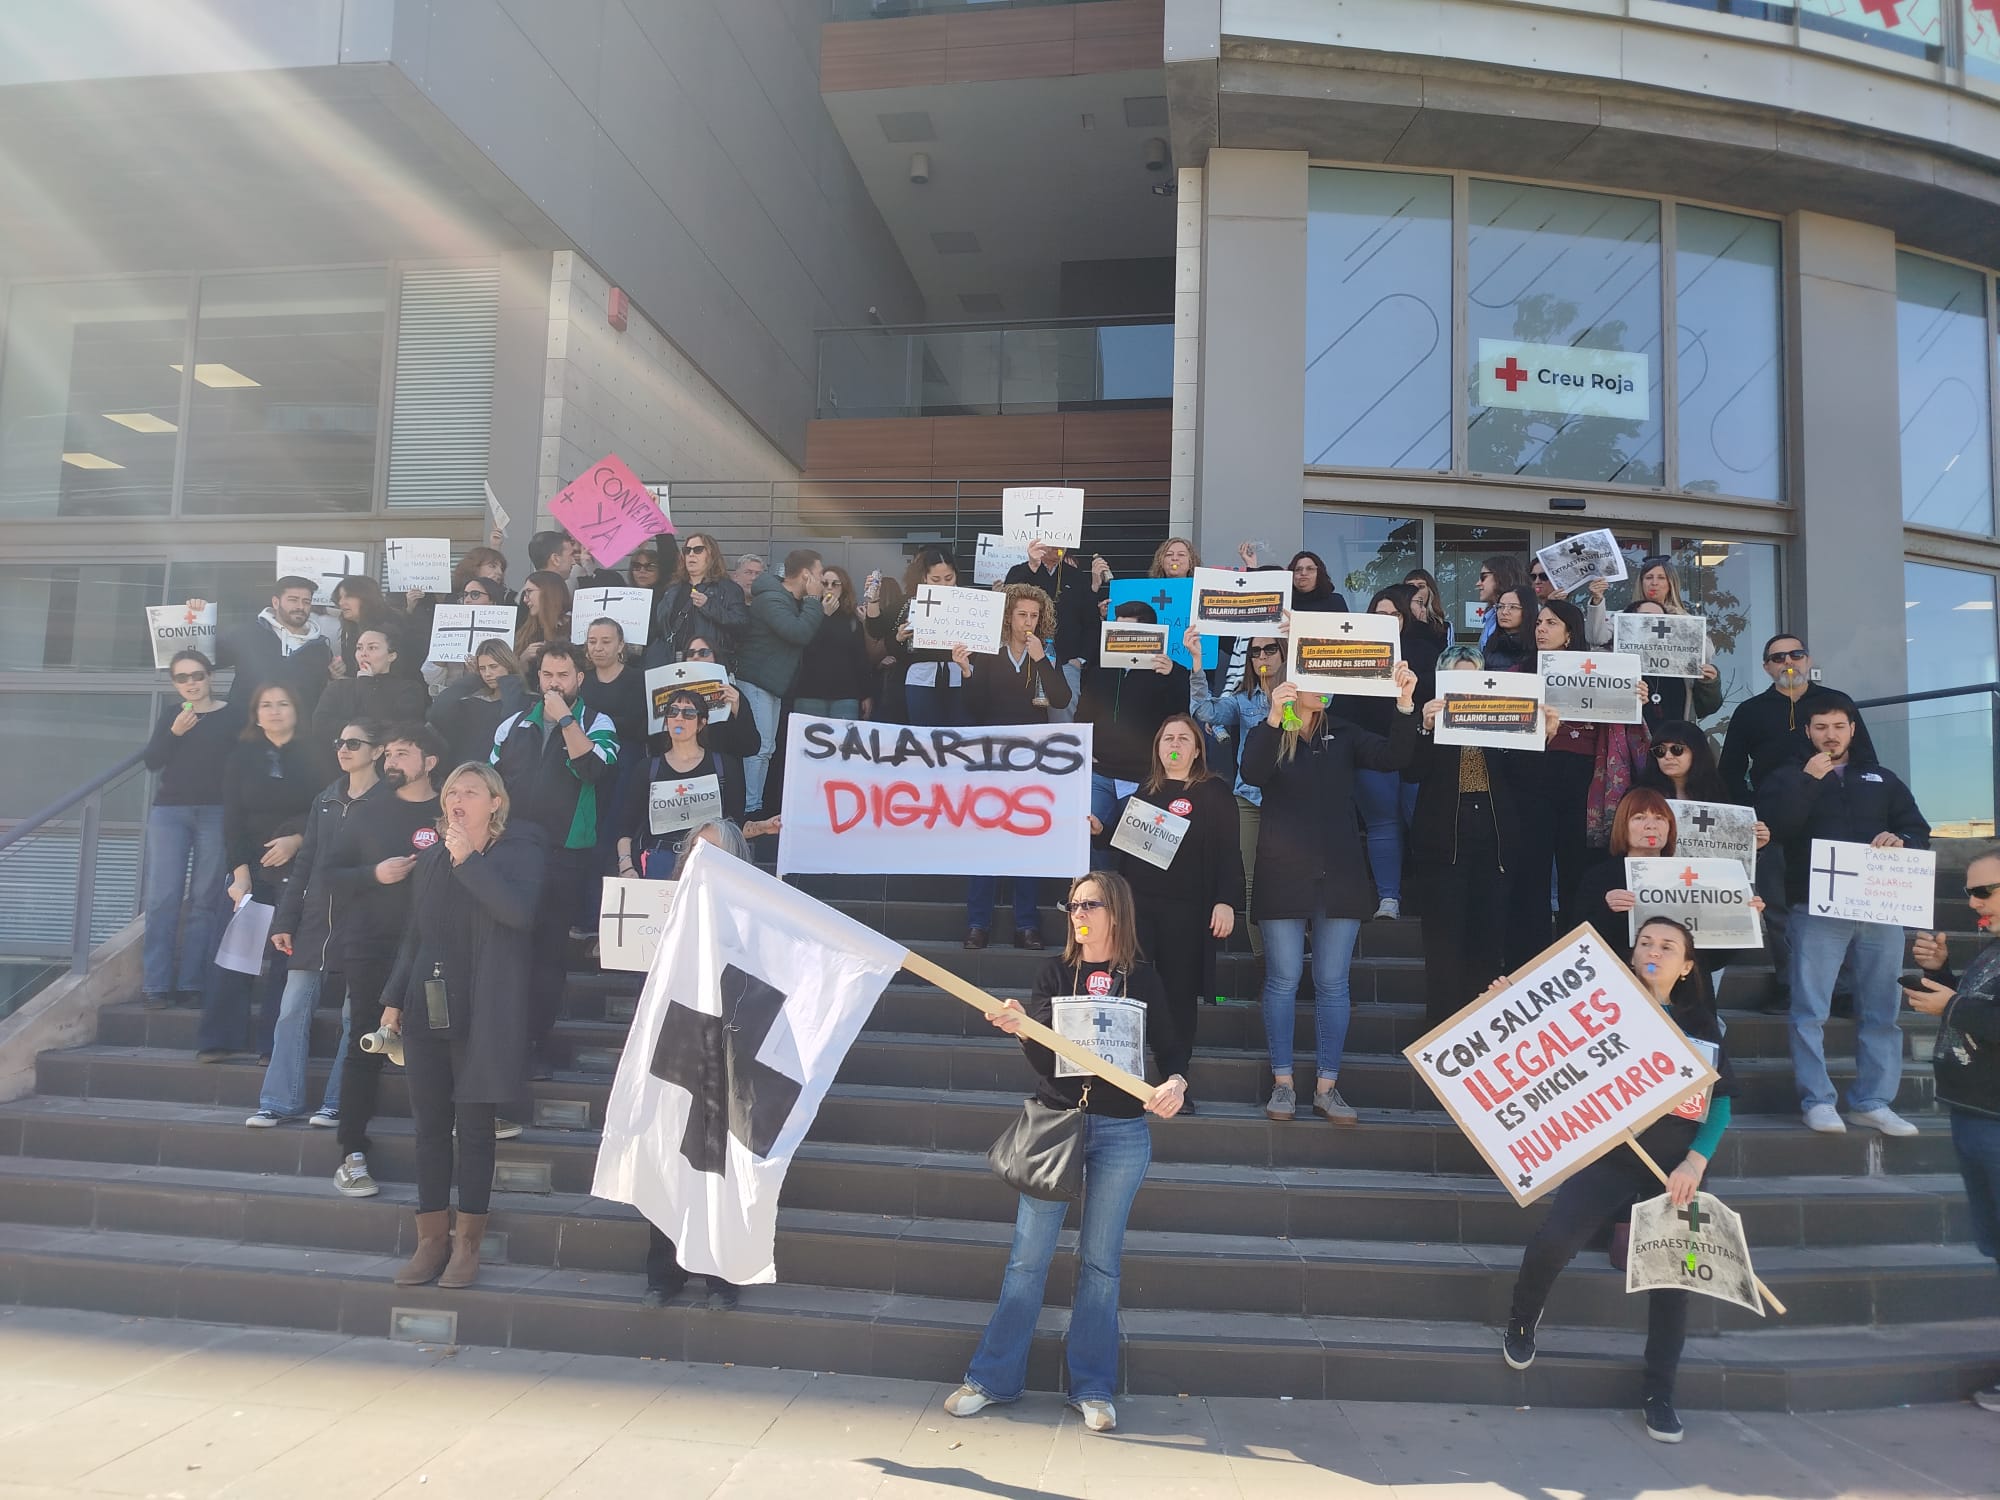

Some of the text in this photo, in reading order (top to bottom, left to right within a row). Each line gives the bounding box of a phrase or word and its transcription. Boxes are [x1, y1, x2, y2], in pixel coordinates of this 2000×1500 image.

[1537, 368, 1635, 395] Creu Roja
[1013, 489, 1065, 501] HUELGA
[580, 501, 622, 550] YA
[1012, 529, 1073, 541] VALENCIA
[1579, 563, 1596, 576] NO
[951, 590, 988, 601] PAGAD
[946, 605, 990, 618] LO QUE
[1248, 606, 1267, 614] SECTOR
[158, 625, 216, 638] CONVENIO
[916, 627, 936, 635] DESDE
[1619, 643, 1699, 653] EXTRAESTATUTARIOS
[1305, 659, 1342, 668] ¡SALARIOS
[1353, 659, 1376, 667] SECTOR
[1377, 659, 1389, 667] YA!
[1649, 657, 1670, 668] NO
[1546, 675, 1632, 689] CONVENIOS
[1580, 698, 1593, 709] SI
[1452, 714, 1487, 722] ¡SALARIOS
[1498, 714, 1520, 722] SECTOR
[1520, 714, 1532, 722] YA!
[804, 722, 1084, 775] SALARIOS
[652, 791, 716, 809] CONVENIOS
[1172, 799, 1190, 811] UGT
[823, 780, 1056, 836] DIGNOS
[680, 812, 690, 822] SI
[415, 831, 435, 841] UGT
[1126, 815, 1180, 845] CONVENIOS
[1143, 841, 1153, 852] SI
[1677, 838, 1749, 851] AESTATUTARIOS
[1864, 848, 1920, 864] PAGAD LO
[1866, 863, 1884, 871] QUE
[1864, 876, 1913, 888] SALARIOS
[1639, 889, 1743, 904] CONVENIOS
[1817, 904, 1898, 923] VALENCIA
[1684, 917, 1699, 932] SI
[1089, 975, 1112, 989] UGT
[1435, 957, 1598, 1077] CON SALARIOS
[1072, 1039, 1138, 1050] RAESTATUTARIOS
[1462, 987, 1622, 1113] ILEGALES
[1495, 1032, 1630, 1132] ES DIFICIL SER
[1507, 1050, 1676, 1174] HUMANITARIO
[1680, 1260, 1713, 1281] NO
